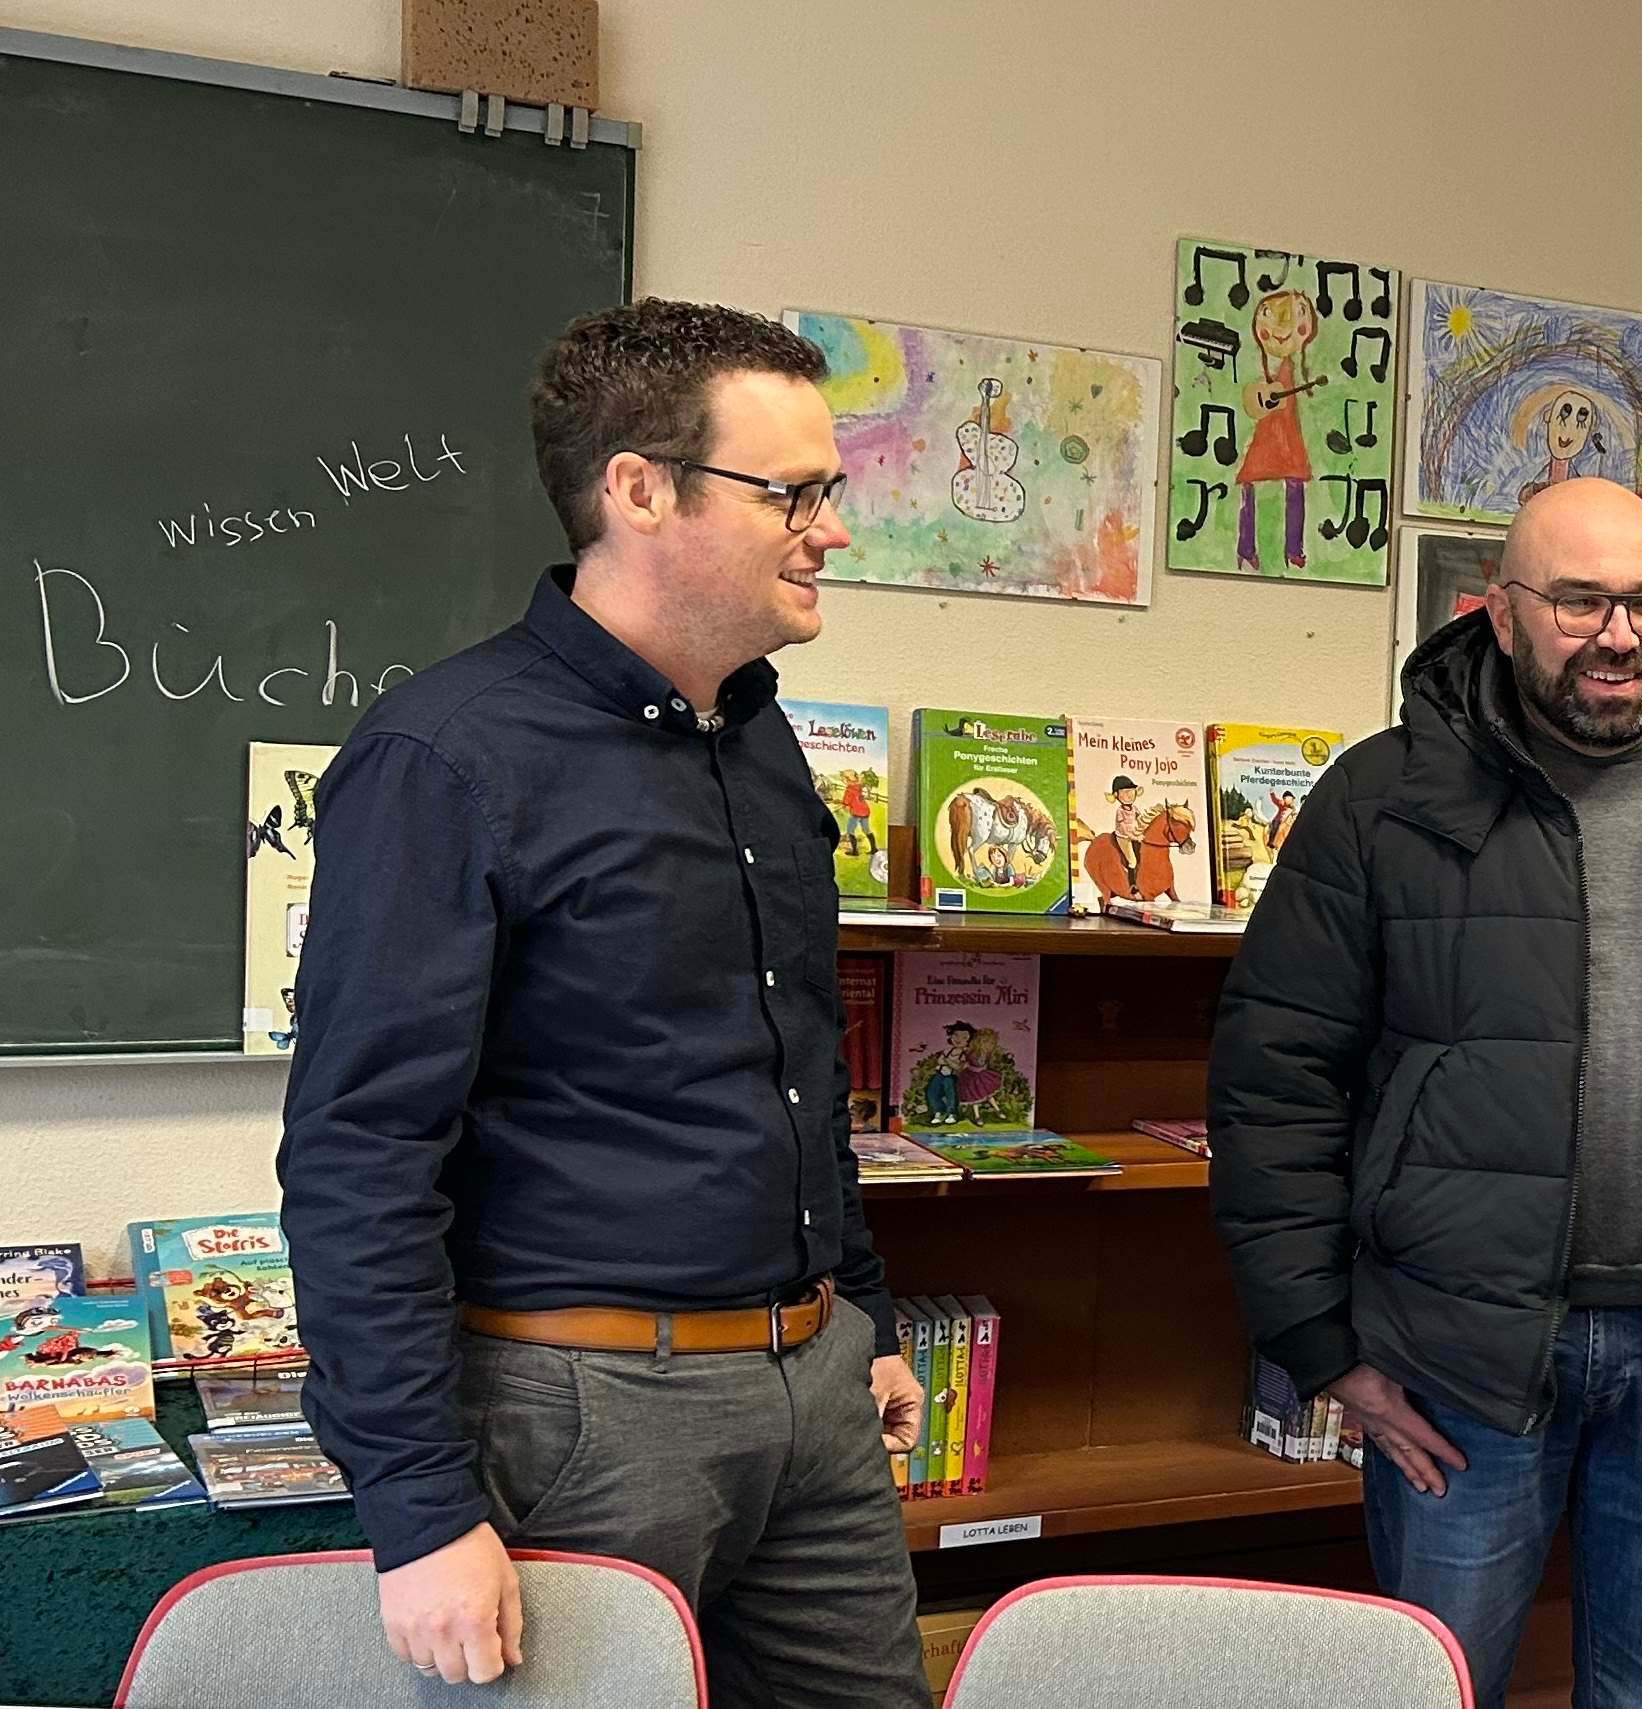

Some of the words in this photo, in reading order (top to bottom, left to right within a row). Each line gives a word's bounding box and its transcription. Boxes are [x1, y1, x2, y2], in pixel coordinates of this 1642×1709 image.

[317, 434, 467, 504] Welt
[808, 719, 876, 741] Leselöwen
[1078, 731, 1109, 750] Mein
[1111, 734, 1156, 752] kleines
[953, 751, 1038, 766] Ponygeschichten
[1120, 754, 1153, 775] Pony
[1154, 756, 1178, 775] Jojo
[1254, 765, 1311, 778] Kunterbunte
[914, 986, 991, 1006] Prinzessin
[994, 985, 1029, 1006] Miri
[213, 1228, 240, 1239] Die
[34, 1247, 72, 1257] Blake
[5, 1375, 128, 1392] BARNABAS
[963, 1525, 996, 1539] LOTTA
[997, 1523, 1028, 1536] LEBEN
